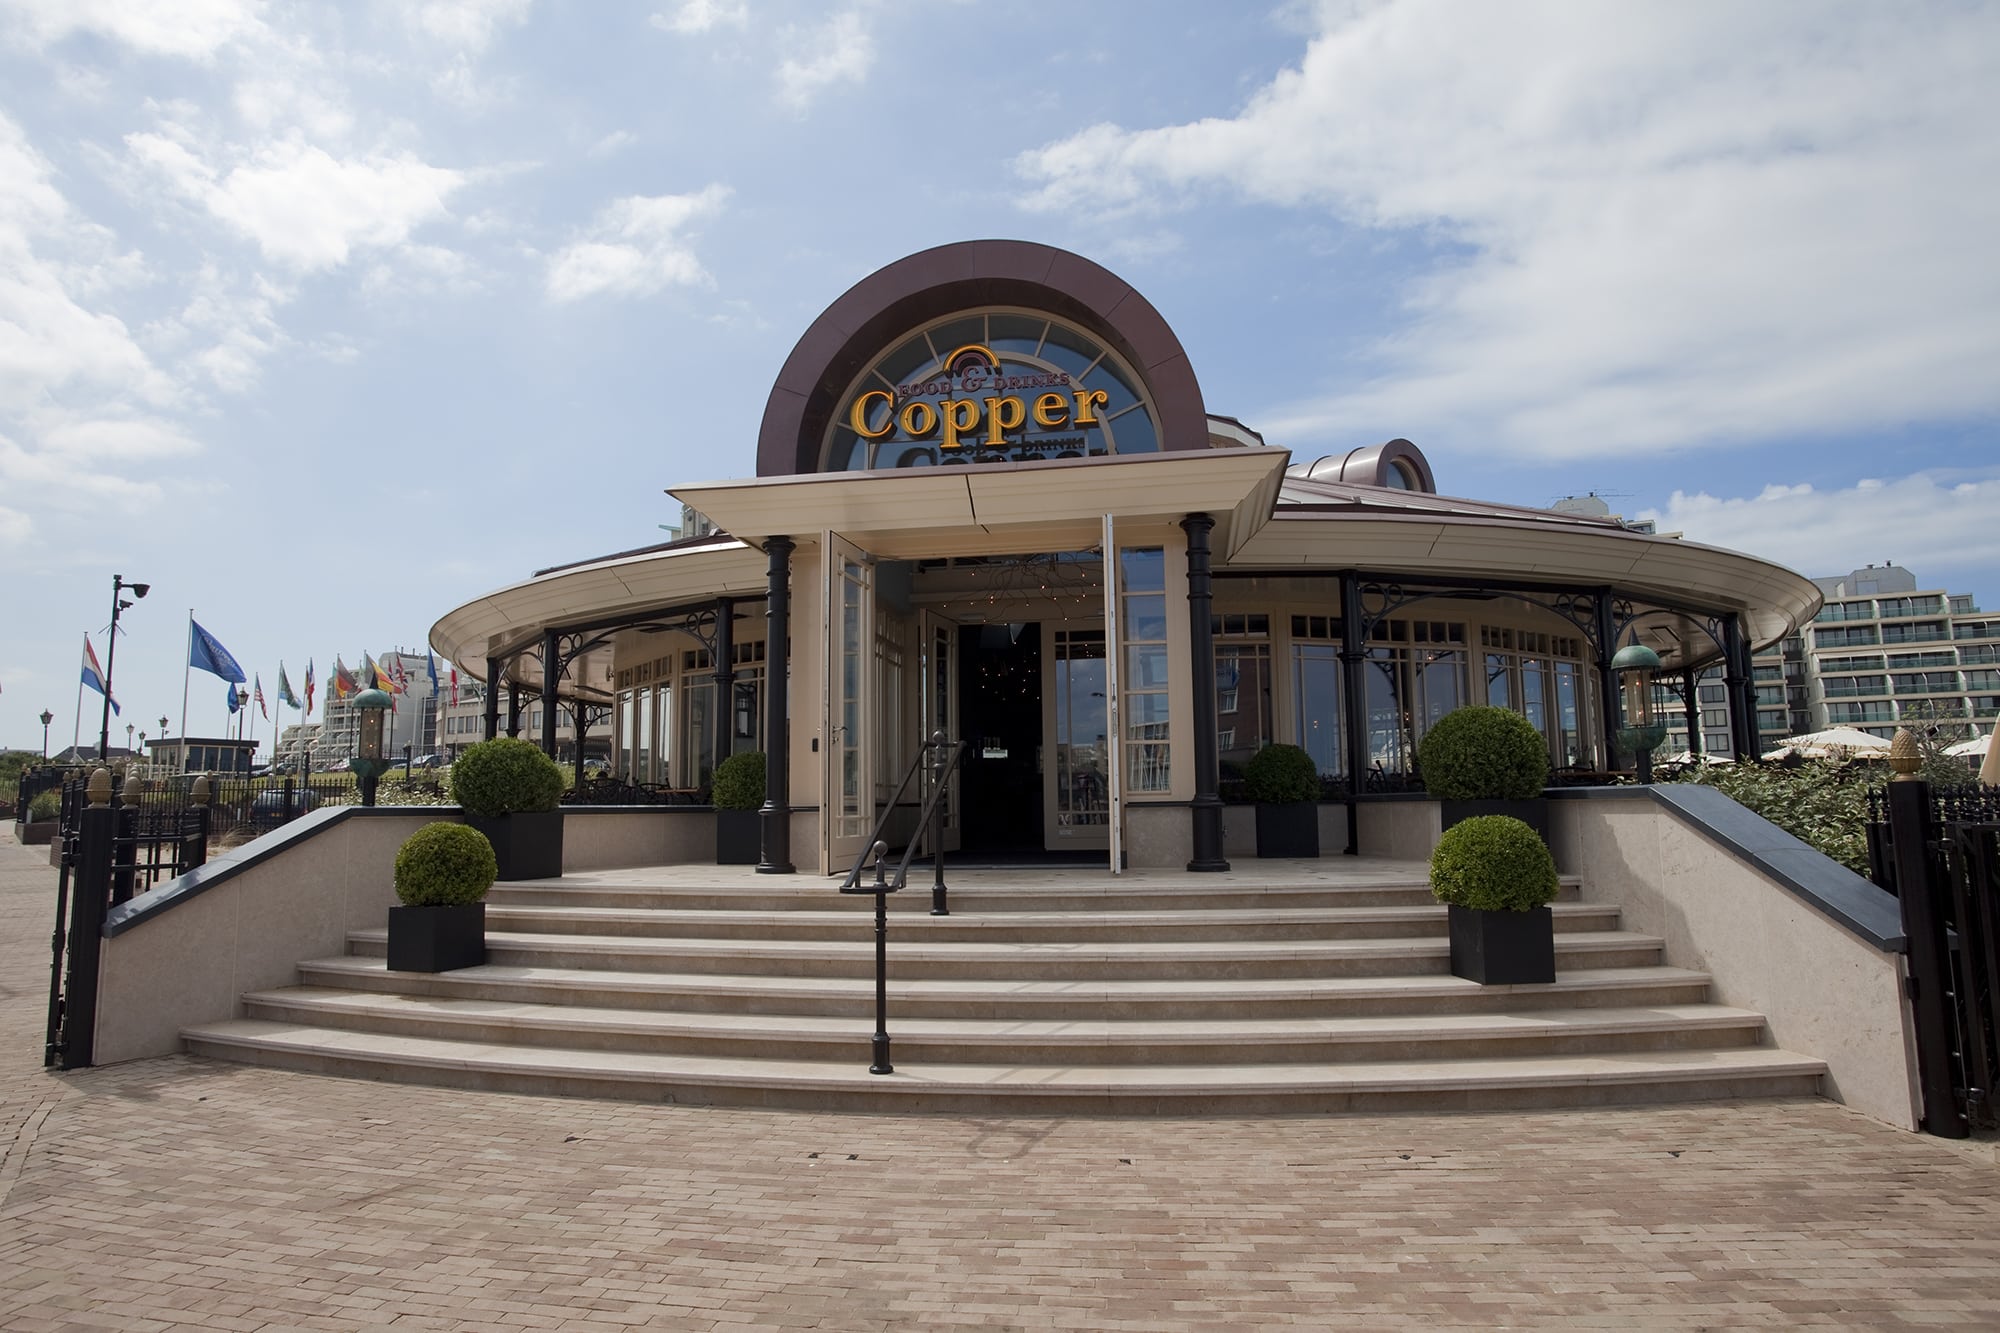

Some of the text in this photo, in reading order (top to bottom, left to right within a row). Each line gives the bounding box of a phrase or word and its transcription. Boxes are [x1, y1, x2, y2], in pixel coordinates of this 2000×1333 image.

[897, 366, 1070, 397] FOOD & DRINKS
[850, 389, 1109, 448] Copper
